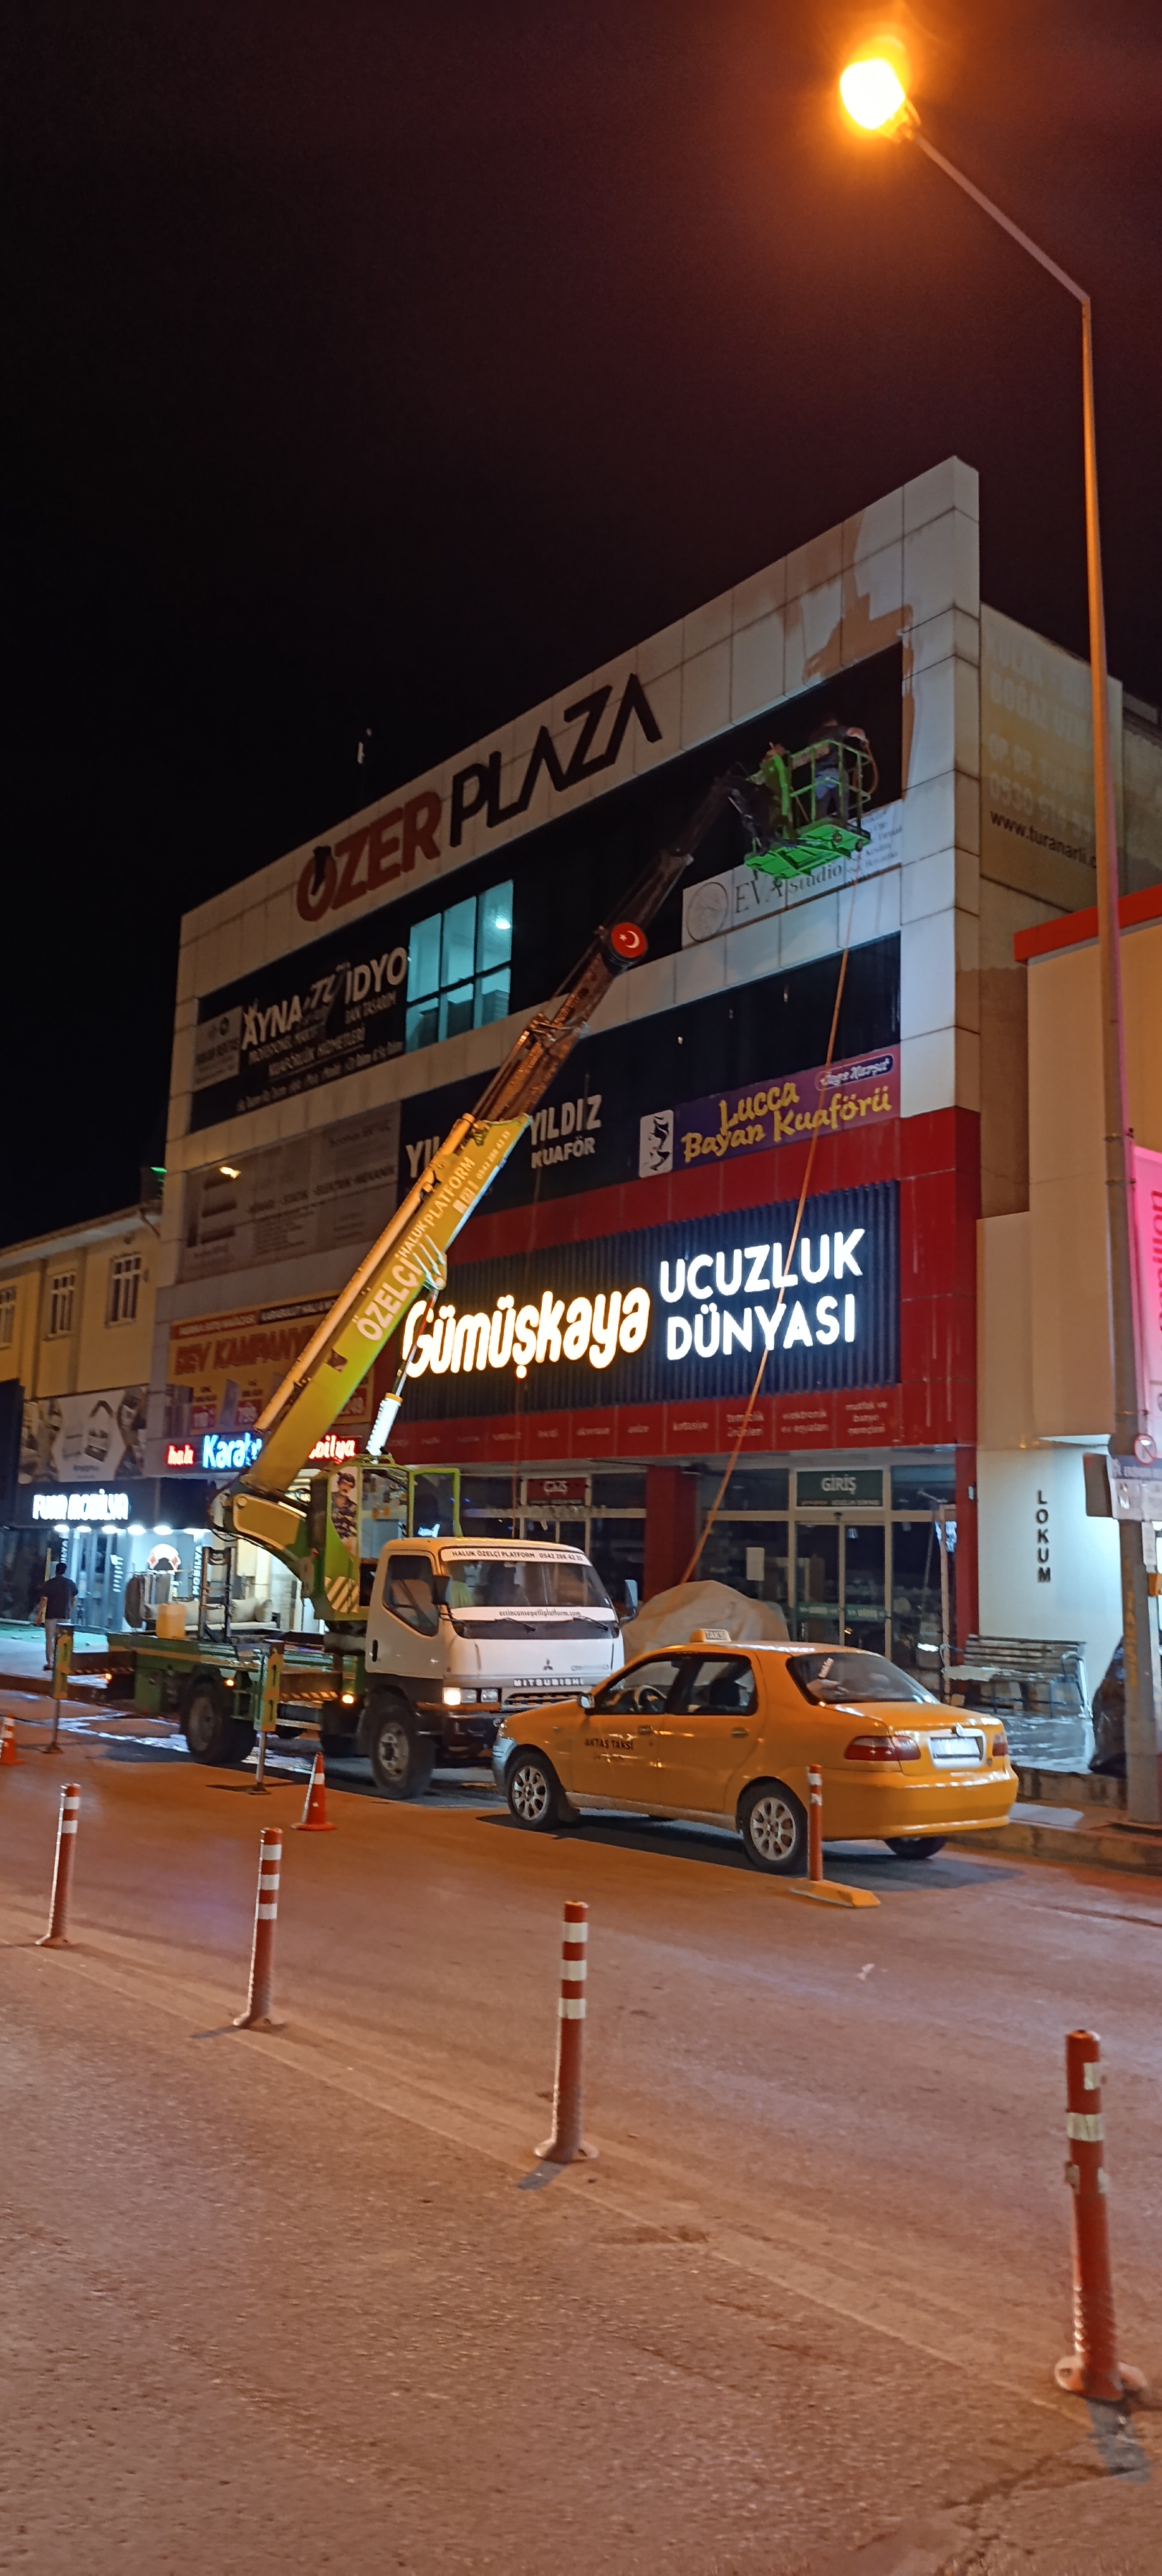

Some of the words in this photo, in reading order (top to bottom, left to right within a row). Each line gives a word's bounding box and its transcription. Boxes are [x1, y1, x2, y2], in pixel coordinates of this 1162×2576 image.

[450, 674, 662, 847] PLAZA
[530, 1094, 602, 1146] YILDIZ
[681, 1124, 767, 1163] Bayan
[773, 1085, 893, 1143] Kuaförü
[719, 1082, 800, 1135] Lucca
[531, 1135, 596, 1169] KUAFÖR
[399, 1220, 430, 1258] HALUK
[426, 1156, 476, 1226] PLATFORM
[352, 1254, 425, 1340] ÖZELÇİ
[659, 1227, 866, 1304] UCUZLUK
[402, 1285, 651, 1380] Gümüşkaya
[666, 1293, 856, 1361] DÜNYASI
[821, 1474, 857, 1495] GİRİŞ
[500, 1551, 536, 1559] PLATFORM
[1036, 1489, 1051, 1583] LOKUM
[513, 1678, 584, 1688] MITSUBISHI
